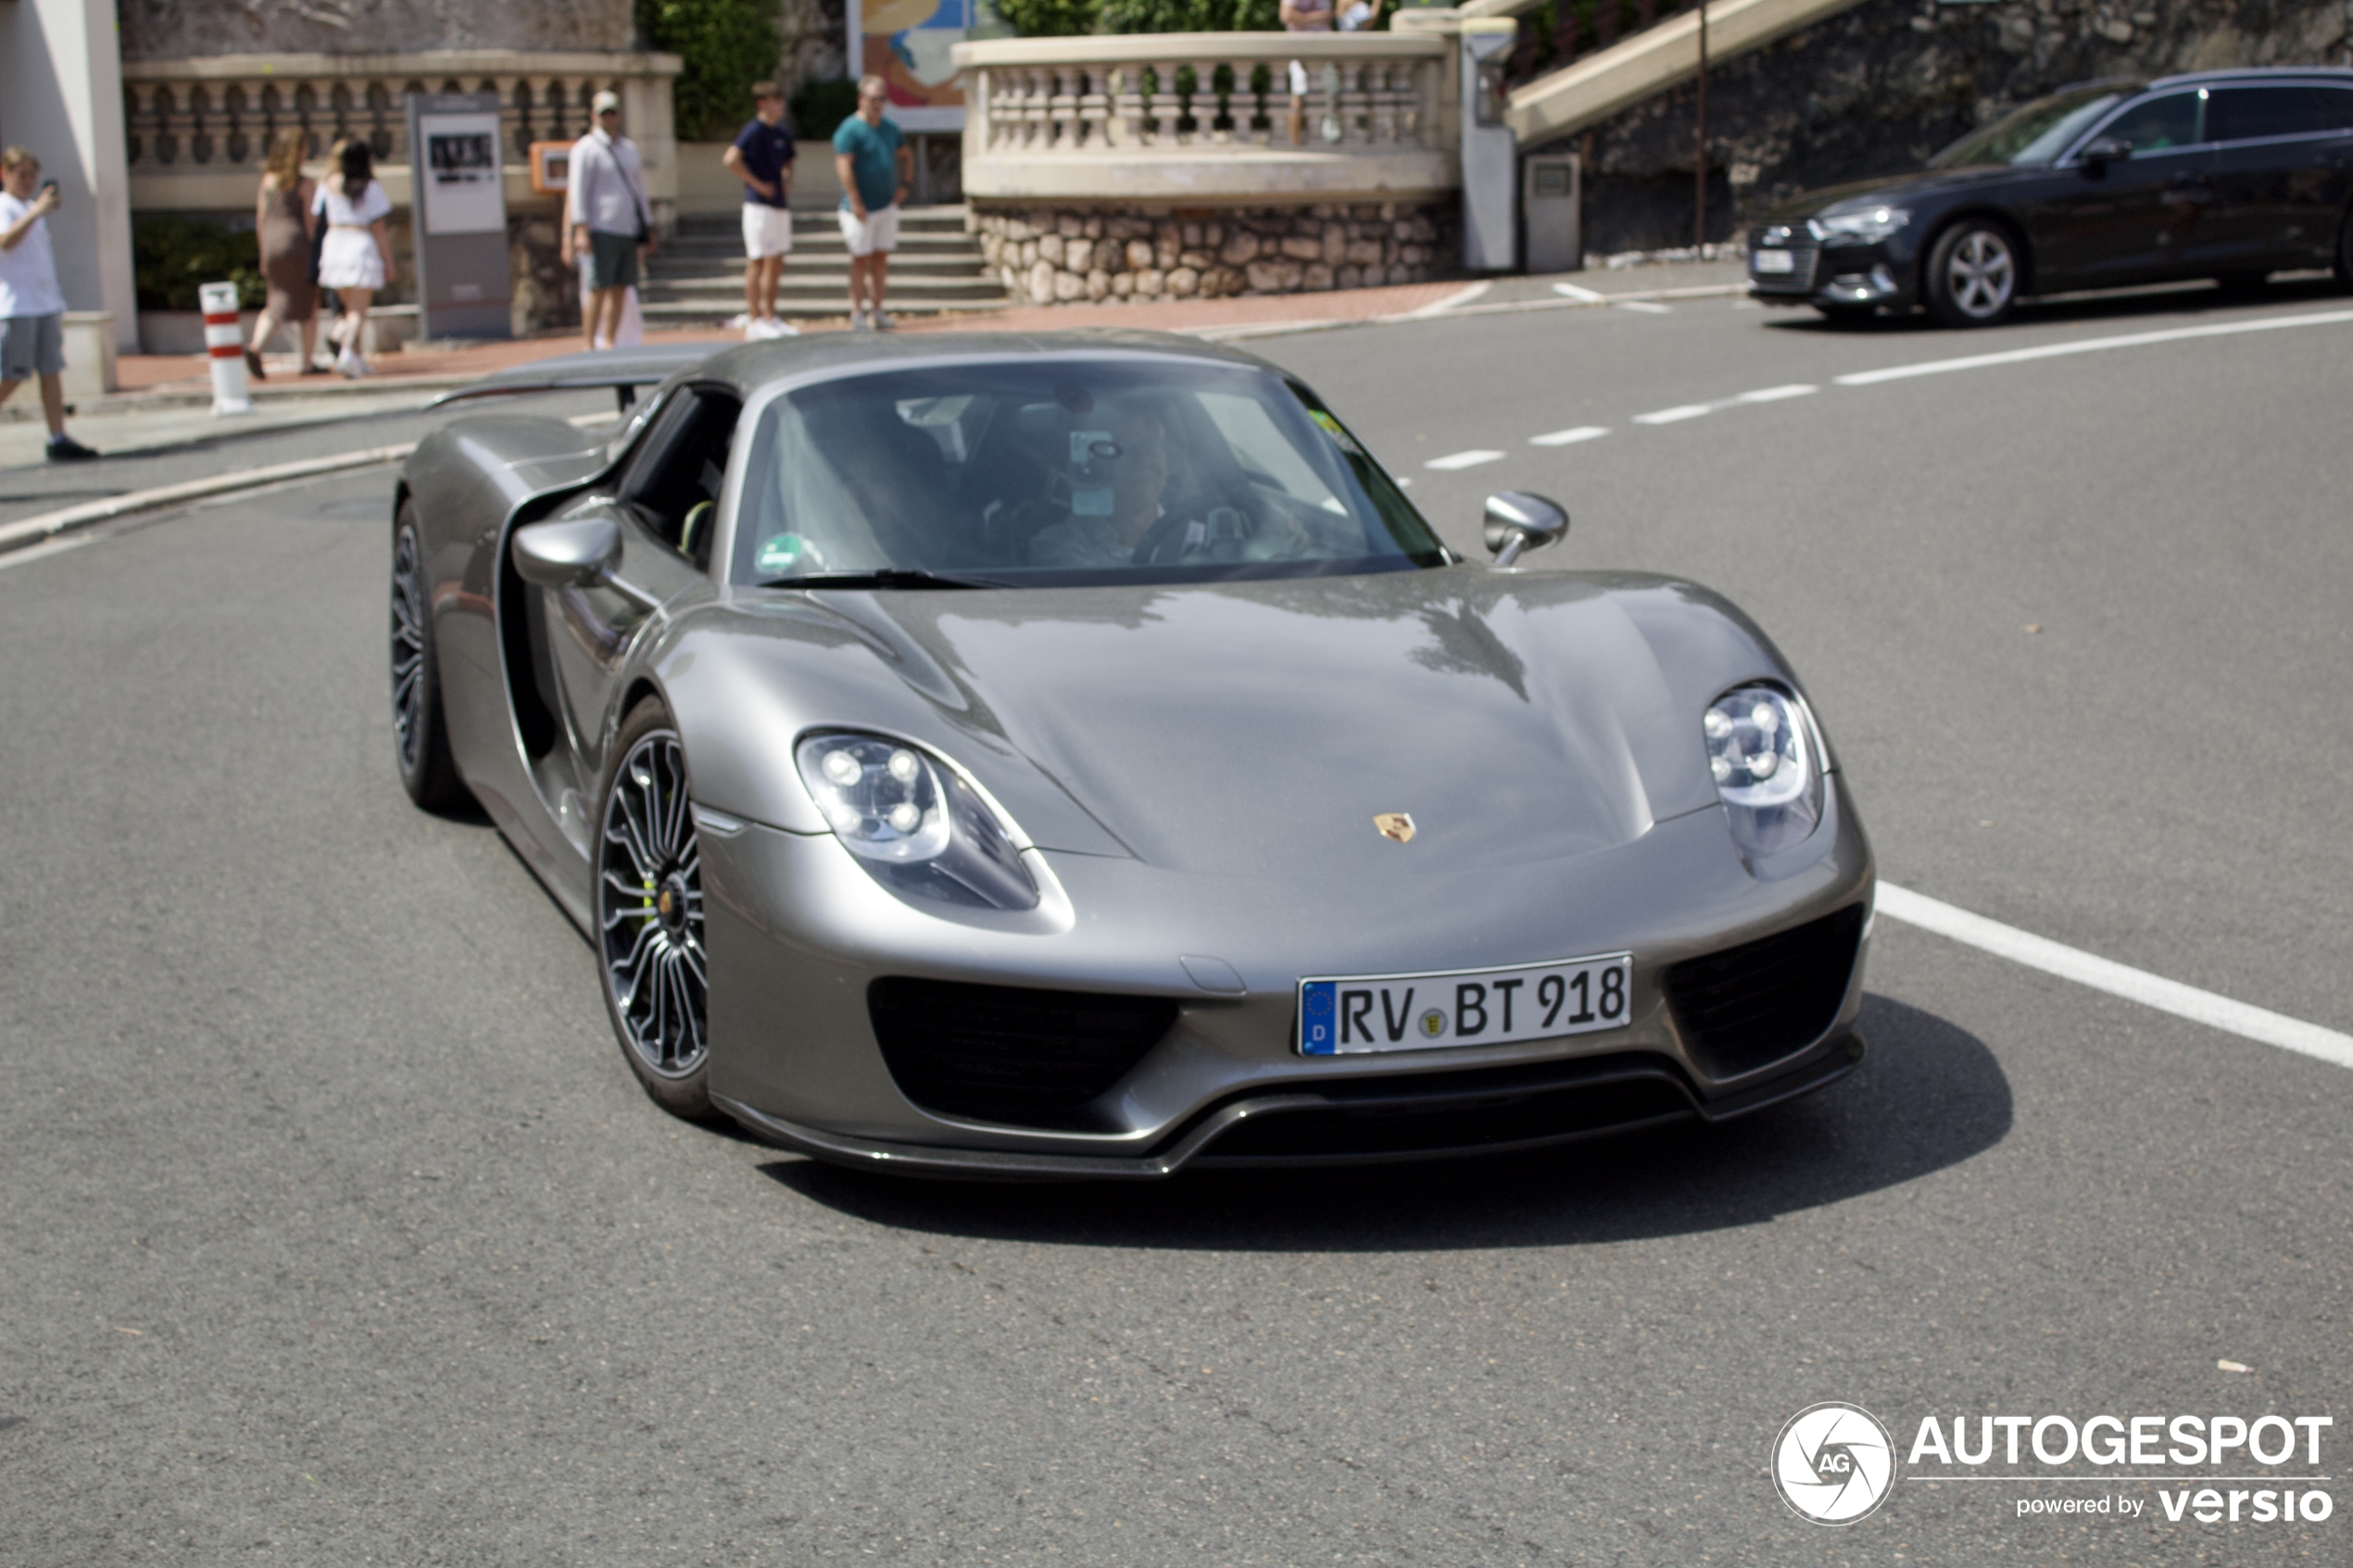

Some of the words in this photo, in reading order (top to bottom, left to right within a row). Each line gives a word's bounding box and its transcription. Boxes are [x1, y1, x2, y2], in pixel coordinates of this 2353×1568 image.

[1340, 988, 1415, 1044] RV
[1455, 978, 1524, 1037] BT
[1538, 966, 1625, 1029] 918
[1312, 1024, 1327, 1042] D
